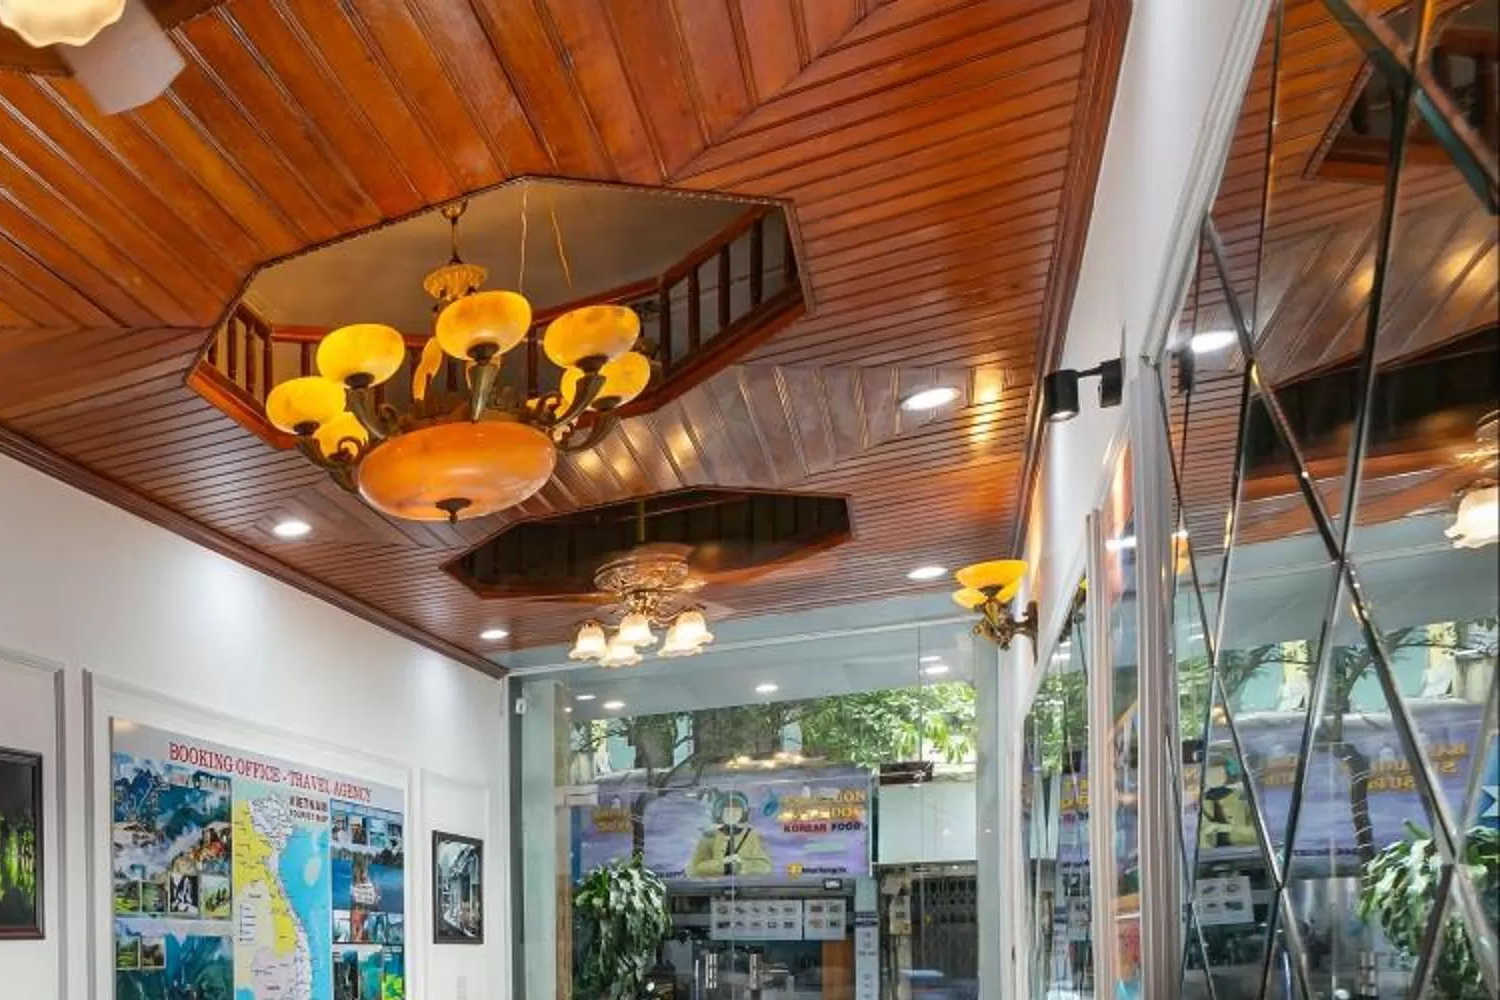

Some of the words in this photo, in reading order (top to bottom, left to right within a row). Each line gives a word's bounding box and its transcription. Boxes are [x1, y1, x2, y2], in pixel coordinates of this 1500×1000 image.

[168, 742, 233, 774] BOOKING
[235, 759, 281, 783] OFFICE
[287, 770, 331, 795] TRAVEL
[333, 781, 372, 802] AGENCY
[783, 823, 828, 833] KOREAN
[831, 821, 861, 832] FOOD
